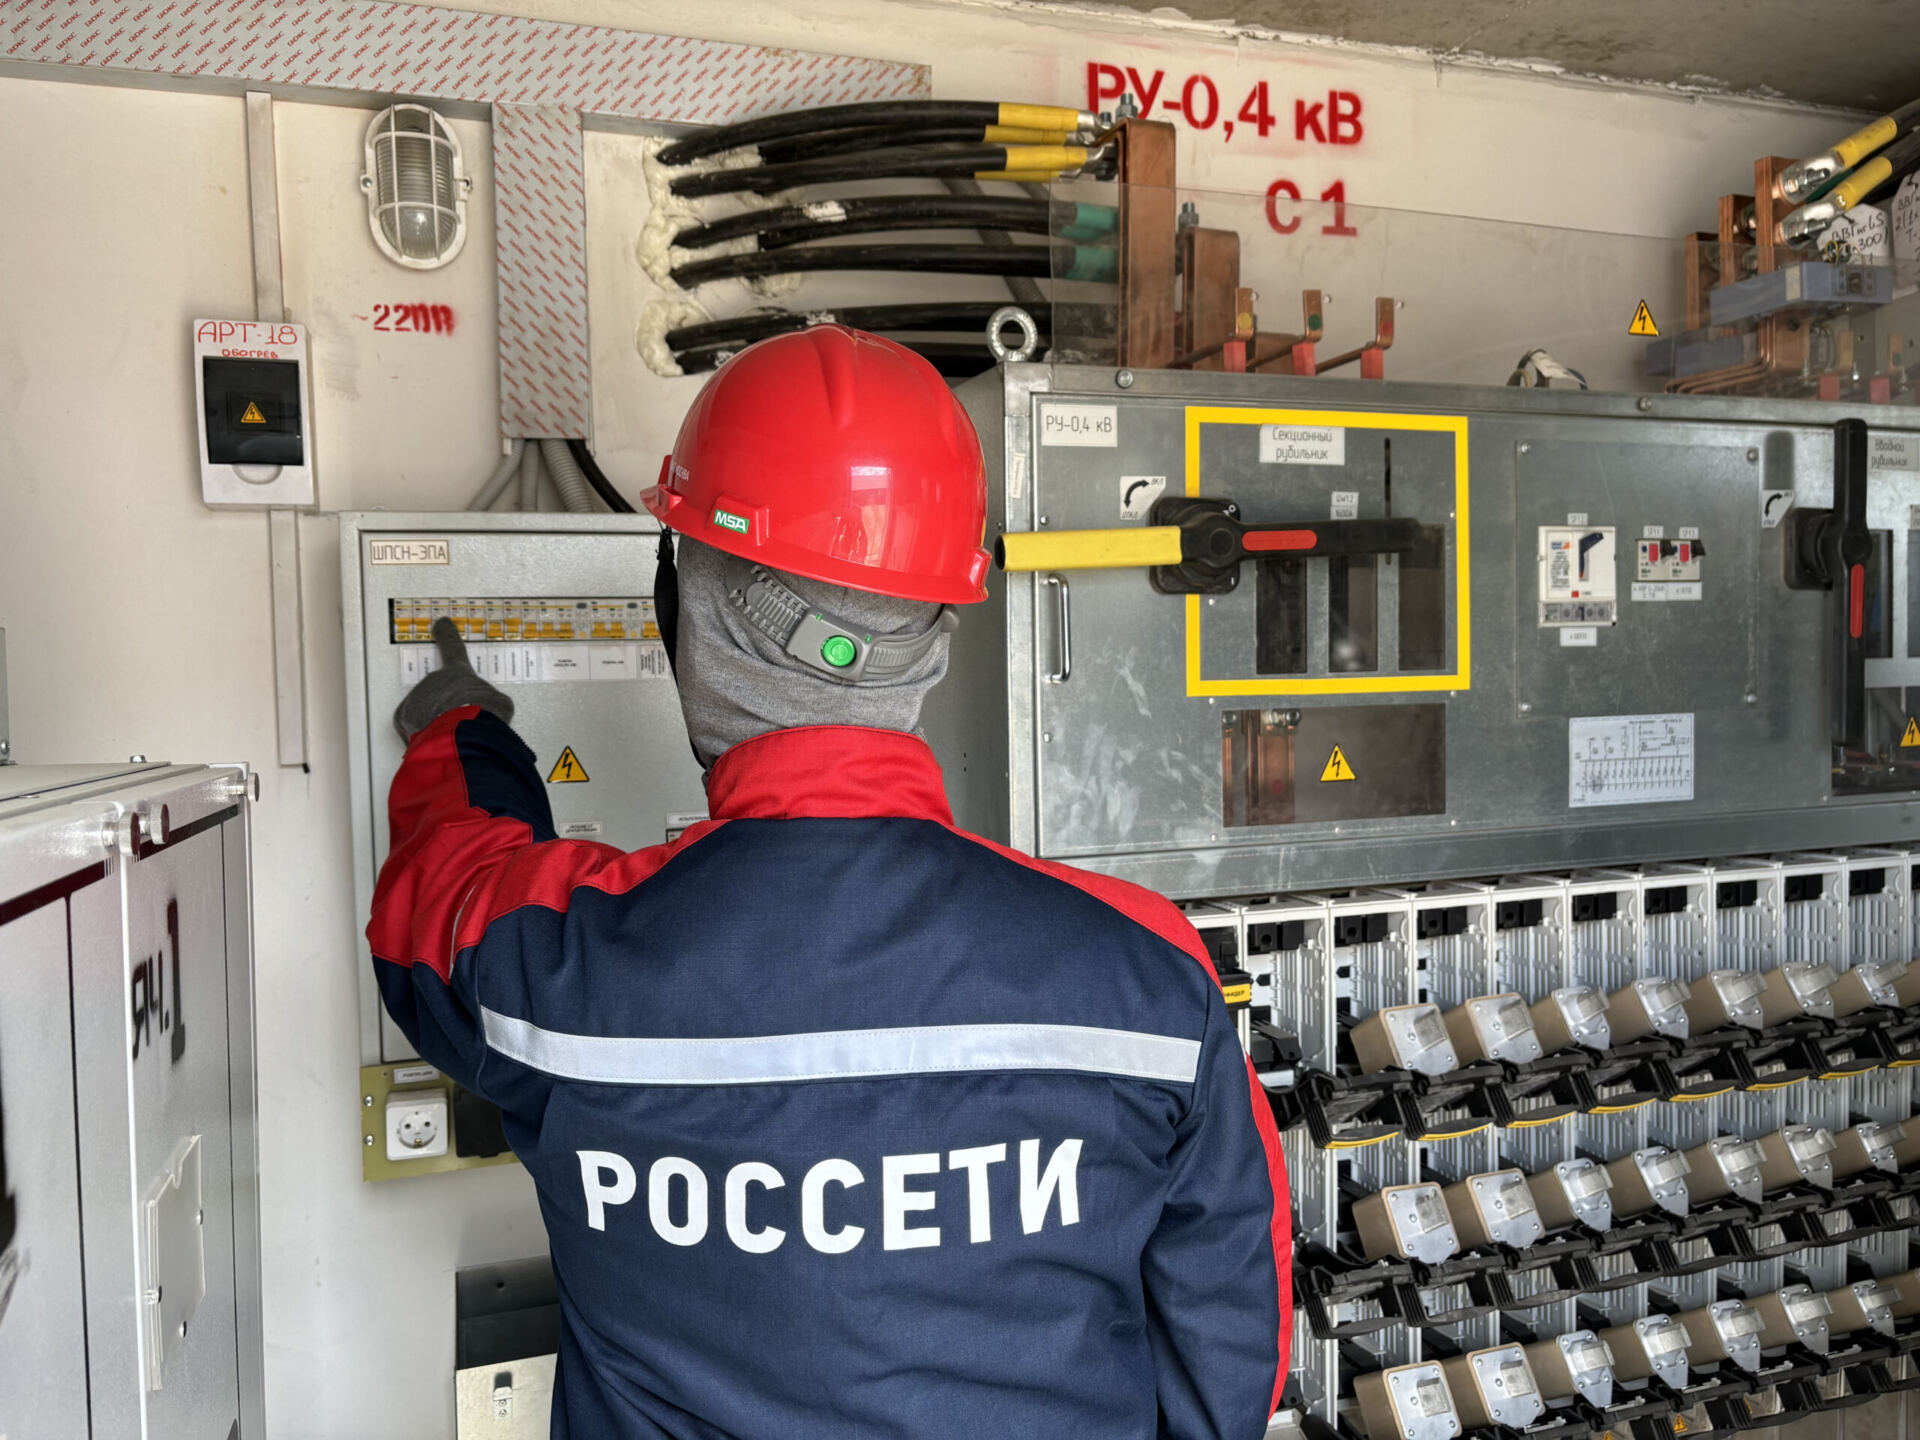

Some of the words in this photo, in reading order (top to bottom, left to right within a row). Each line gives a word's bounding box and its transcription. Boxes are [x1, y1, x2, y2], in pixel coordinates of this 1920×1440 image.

[1086, 61, 1275, 143] РУ-0,4
[1295, 90, 1364, 146] кВ
[1265, 178, 1302, 235] С
[1321, 180, 1358, 237] 1
[1045, 414, 1090, 434] РУ-0,4
[1096, 416, 1113, 433] кВ
[1272, 426, 1333, 442] Секционный
[1275, 445, 1328, 461] рубильник
[714, 511, 747, 532] MSA
[576, 1138, 1084, 1254] РОССЕТИ
